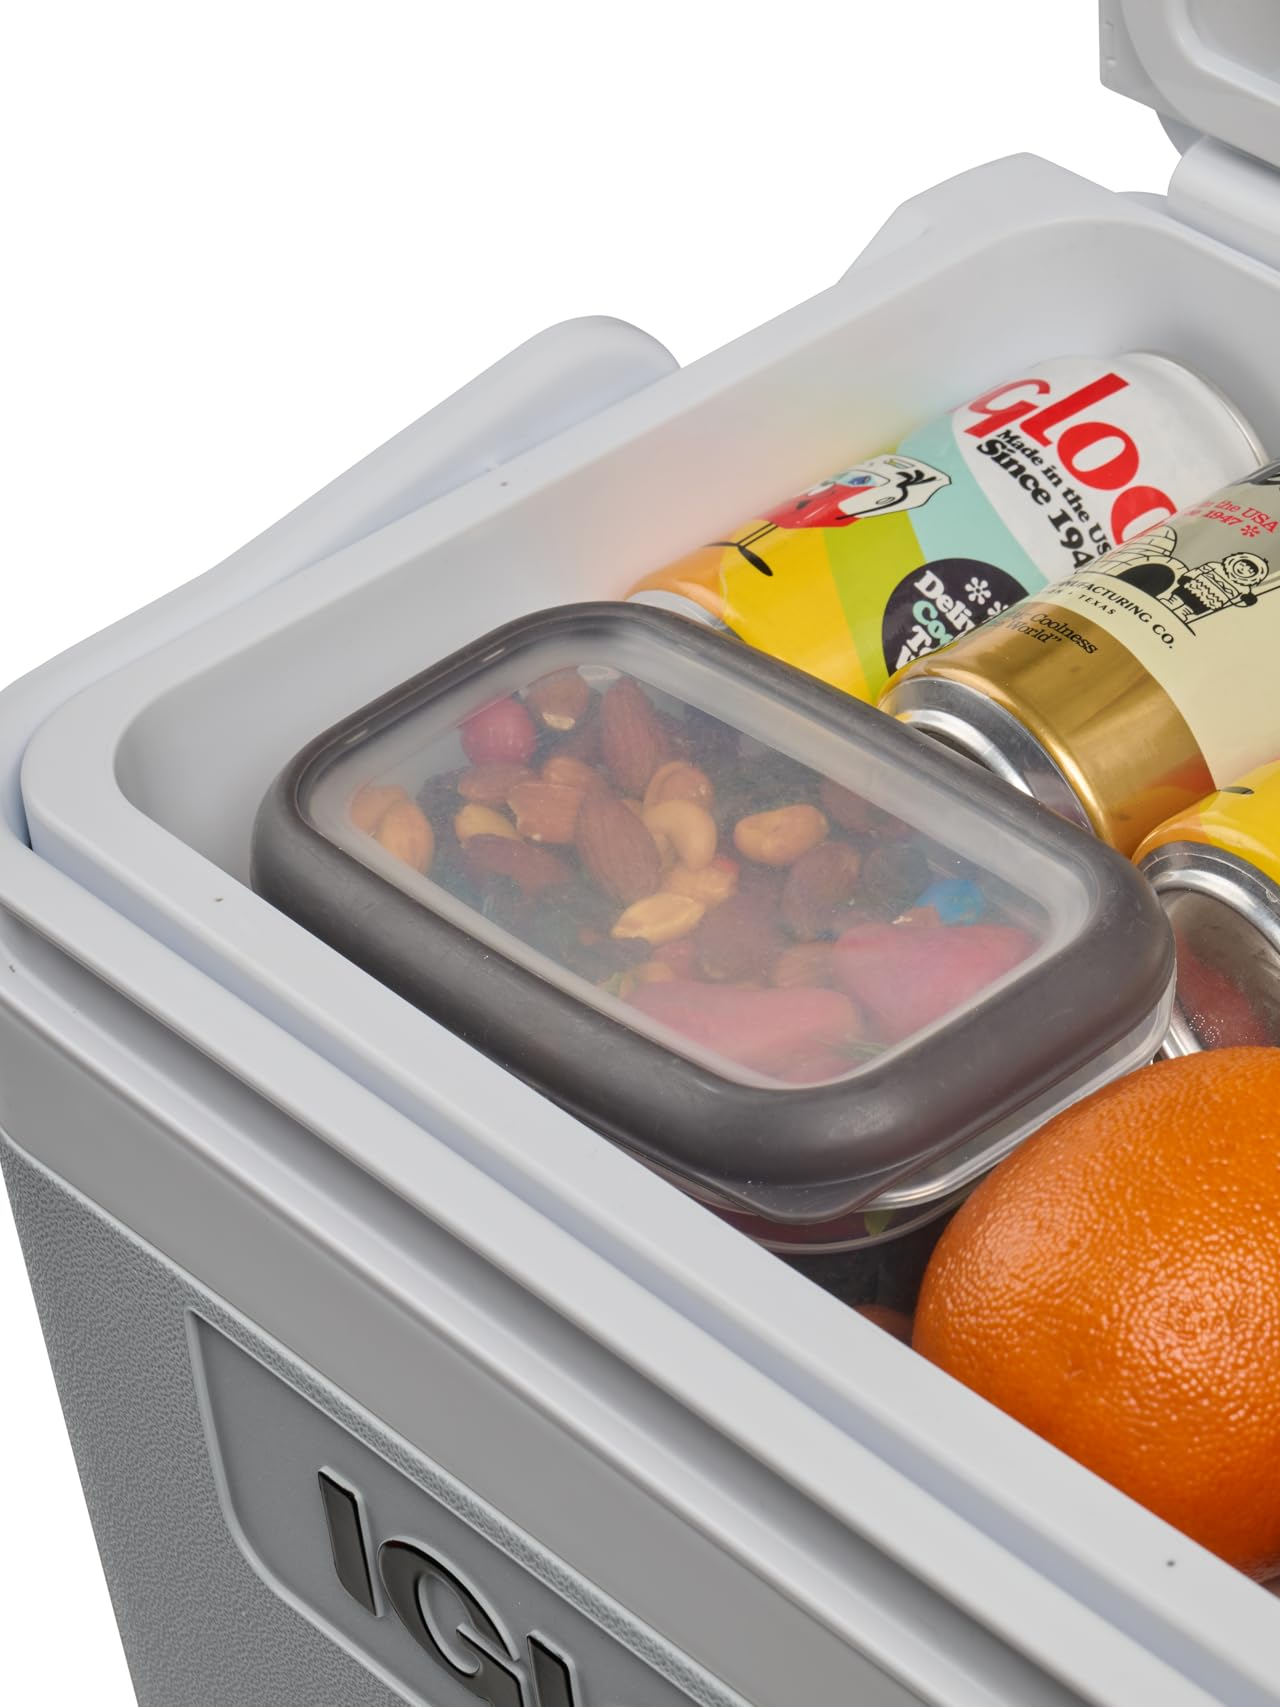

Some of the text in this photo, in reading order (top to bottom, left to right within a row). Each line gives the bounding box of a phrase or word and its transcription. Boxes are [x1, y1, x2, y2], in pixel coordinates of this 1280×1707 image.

[977, 438, 1096, 569] Since 194
[996, 429, 1113, 556] Made in the US
[1241, 507, 1279, 534] USA
[914, 570, 976, 631] Deliv
[1077, 593, 1117, 616] TEXAS
[1030, 612, 1099, 655] Coolness
[1151, 623, 1178, 650] CO.
